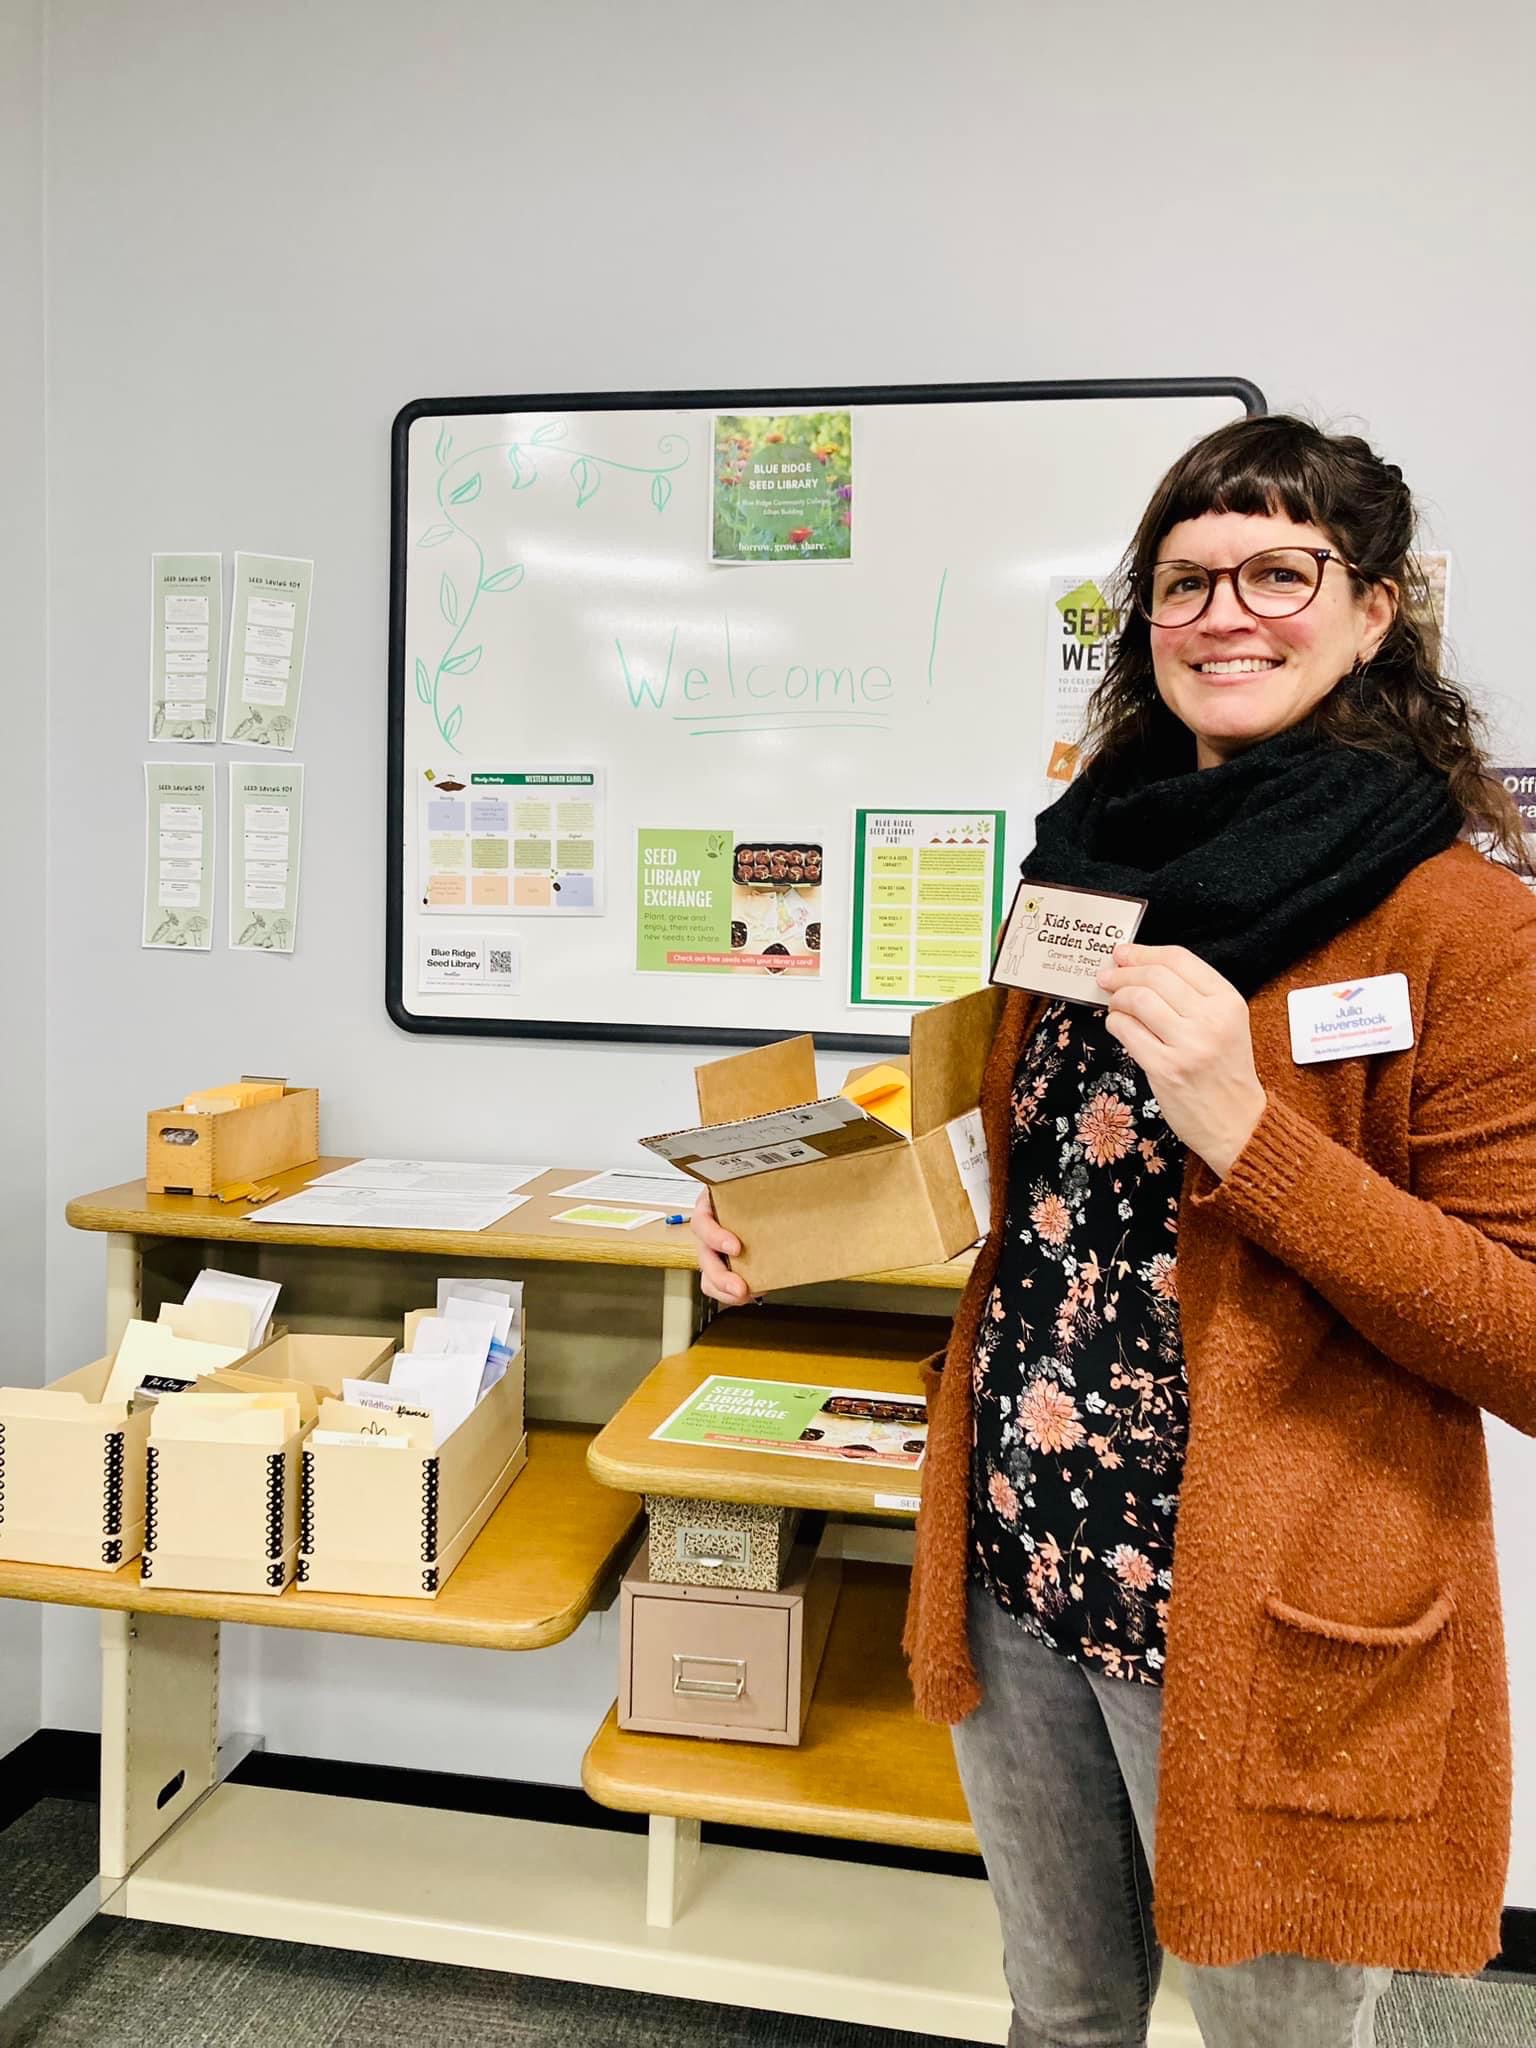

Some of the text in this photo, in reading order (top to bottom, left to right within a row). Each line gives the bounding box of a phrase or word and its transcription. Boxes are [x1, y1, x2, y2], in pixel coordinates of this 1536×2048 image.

[754, 462, 812, 474] BLUE RIDGE
[749, 478, 819, 490] SEED LIBRARY
[1062, 643, 1119, 671] WEE
[875, 819, 912, 827] BLUE RIDGE
[644, 848, 677, 865] SEED
[644, 868, 701, 887] LIBRARY
[644, 889, 713, 908] EXCHANGE
[668, 914, 689, 922] grow
[1043, 913, 1070, 930] Kids
[1072, 919, 1103, 935] Seed
[1037, 930, 1083, 950] Garden
[431, 948, 476, 959] Blue Ridge
[426, 959, 480, 970] Seed Library
[756, 957, 773, 965] your
[774, 958, 795, 966] library
[1335, 1006, 1363, 1019] Julia
[711, 1385, 756, 1397] SEED
[360, 1399, 393, 1411] Wildflo
[703, 1394, 780, 1408] LIBRARY
[695, 1402, 790, 1420] EXCHANGE
[900, 1499, 921, 1508] SEE
